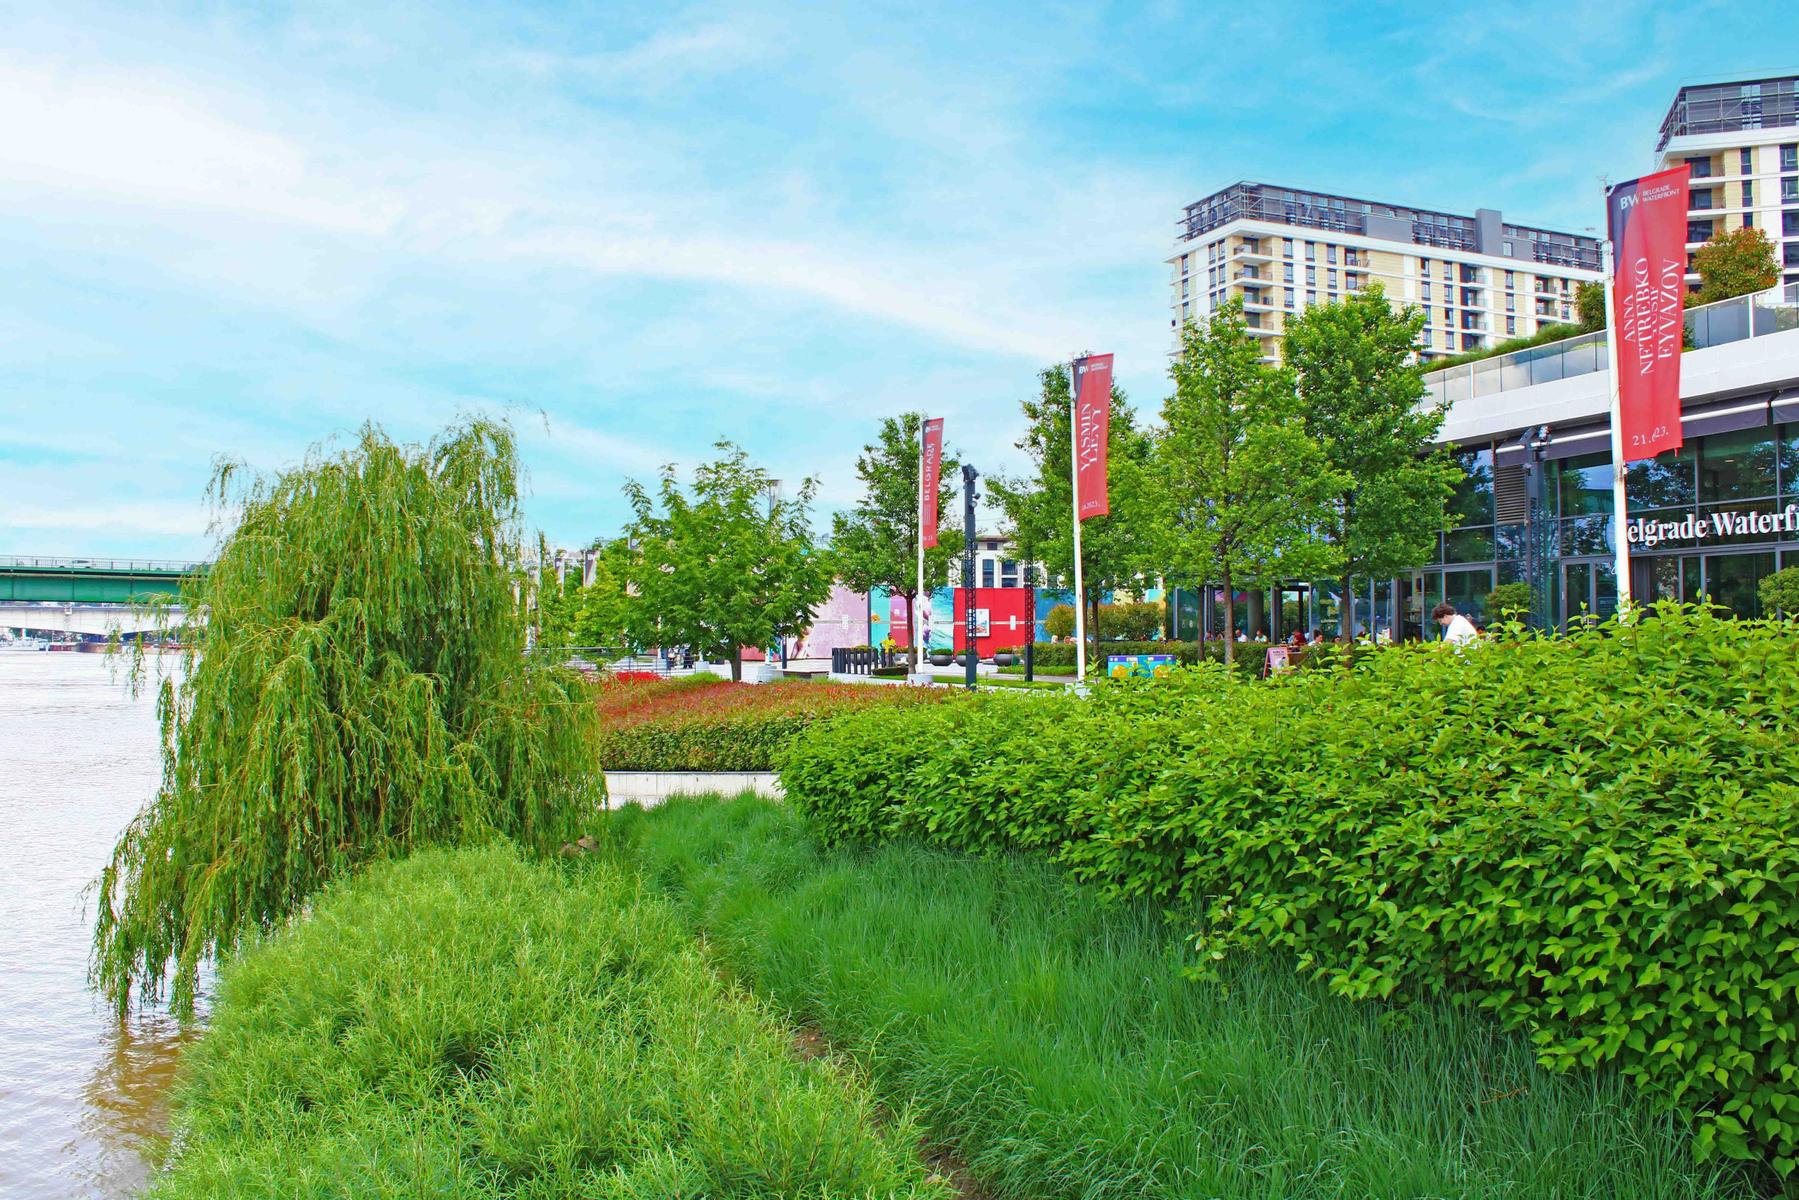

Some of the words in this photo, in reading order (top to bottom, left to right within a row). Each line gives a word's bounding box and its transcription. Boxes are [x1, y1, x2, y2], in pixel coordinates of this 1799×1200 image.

[1620, 194, 1640, 210] BW
[1642, 184, 1670, 197] BELGRADE
[1642, 188, 1680, 202] WATERFRONT
[1624, 294, 1636, 342] ANNA
[1635, 257, 1655, 377] NETREBKO
[1658, 258, 1680, 360] EYVAZOV
[1080, 403, 1091, 472] YASMIN
[1089, 408, 1102, 463] LEVY
[1628, 513, 1707, 546] elgrade
